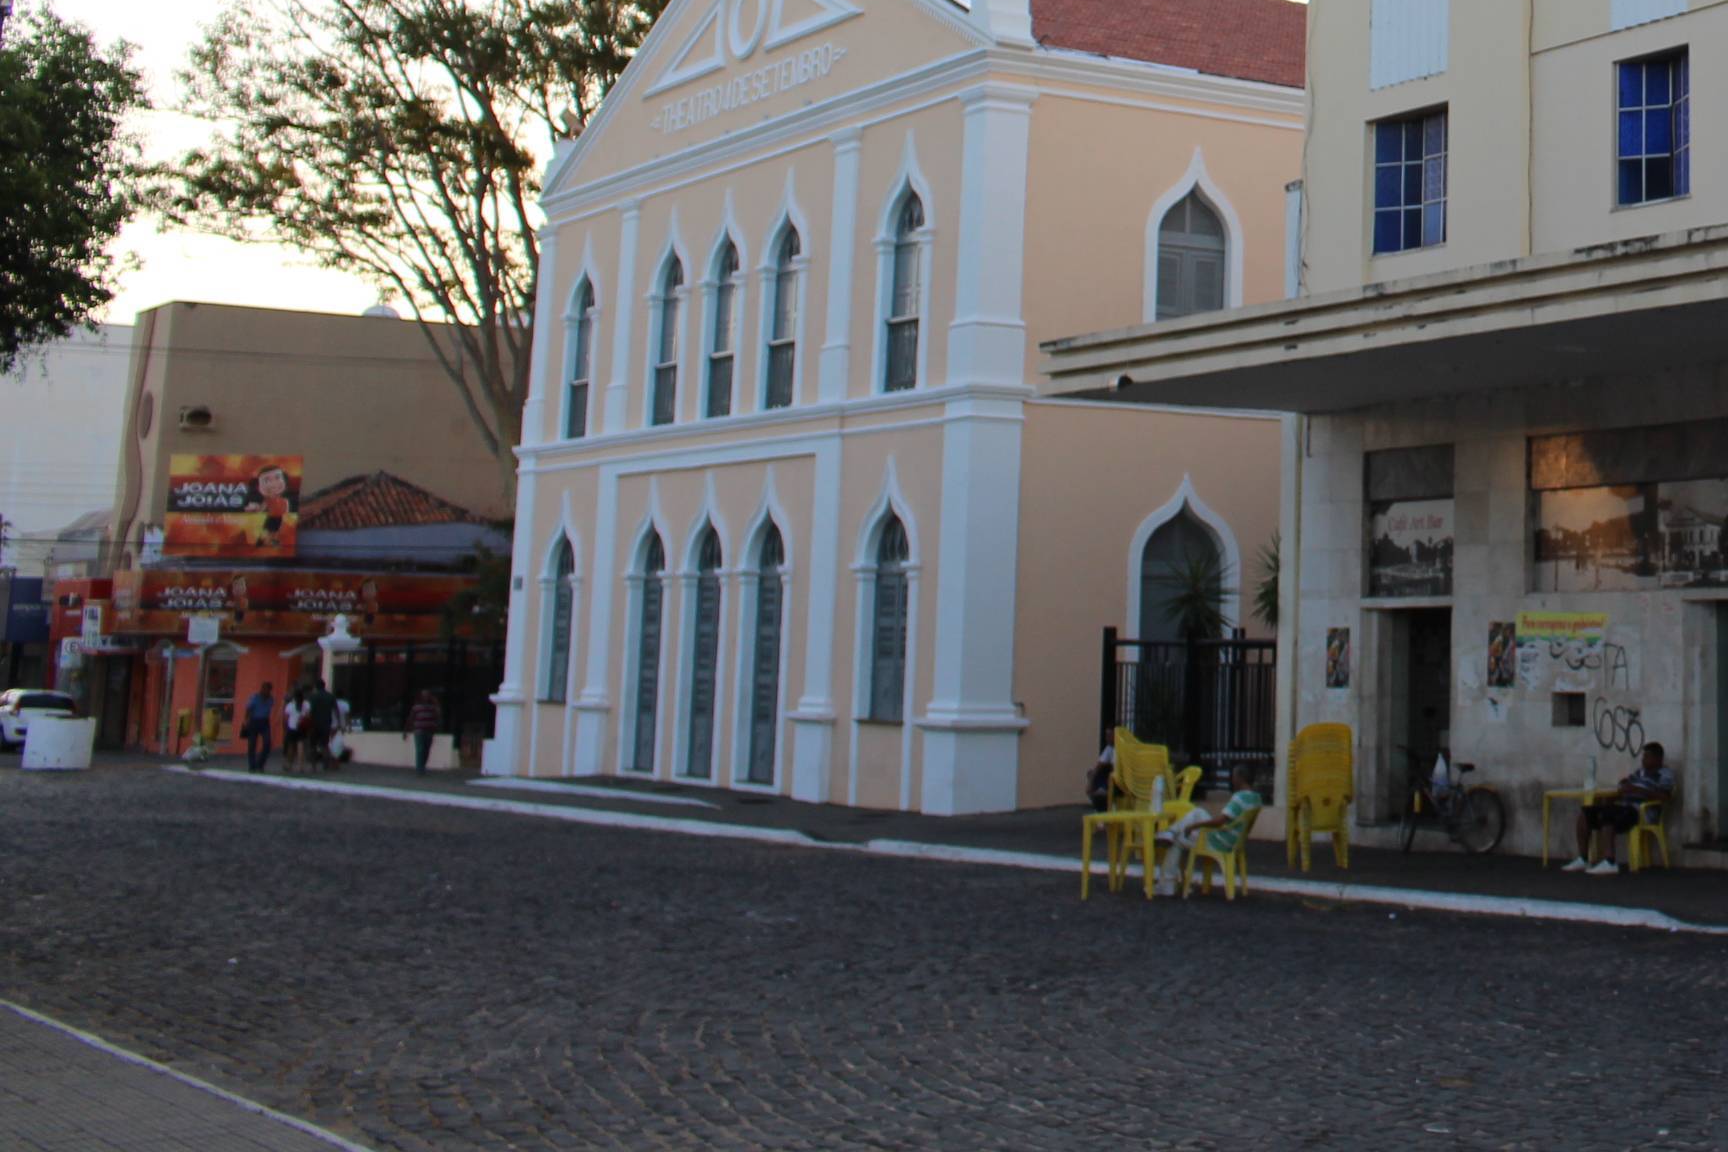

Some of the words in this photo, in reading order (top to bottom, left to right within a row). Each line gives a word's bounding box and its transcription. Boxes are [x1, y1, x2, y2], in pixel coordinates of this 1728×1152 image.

[663, 86, 721, 135] THEATRO
[731, 73, 752, 110] DE
[751, 42, 833, 102] SETEMBRO
[174, 481, 249, 495] JOANA
[157, 586, 228, 598] JOANA
[286, 588, 358, 601] JOANA
